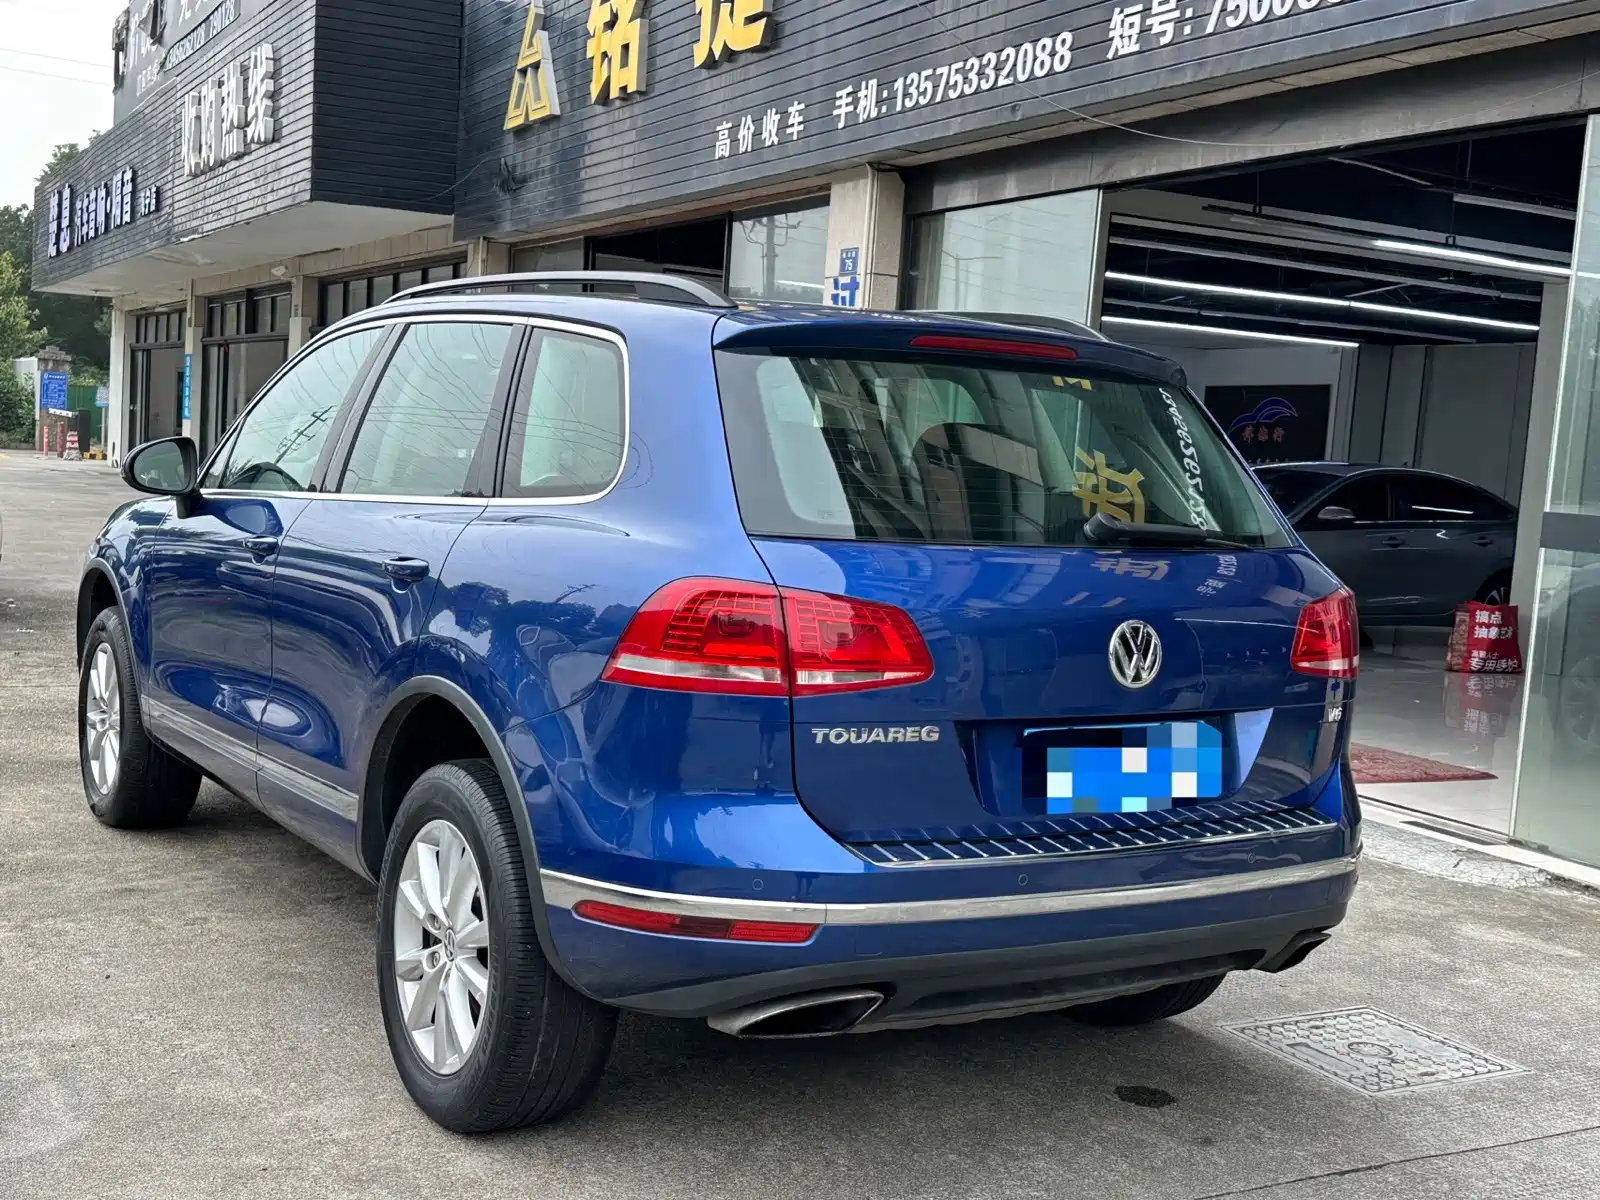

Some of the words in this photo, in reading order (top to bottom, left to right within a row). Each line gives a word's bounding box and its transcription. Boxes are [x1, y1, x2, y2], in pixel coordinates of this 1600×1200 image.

[714, 101, 806, 159] 高价收车
[832, 31, 1075, 129] 手机:13575332088
[181, 43, 275, 176] 收购热线
[844, 258, 854, 271] 75
[1475, 609, 1502, 624] 搞点
[811, 725, 941, 745] TOUAREG
